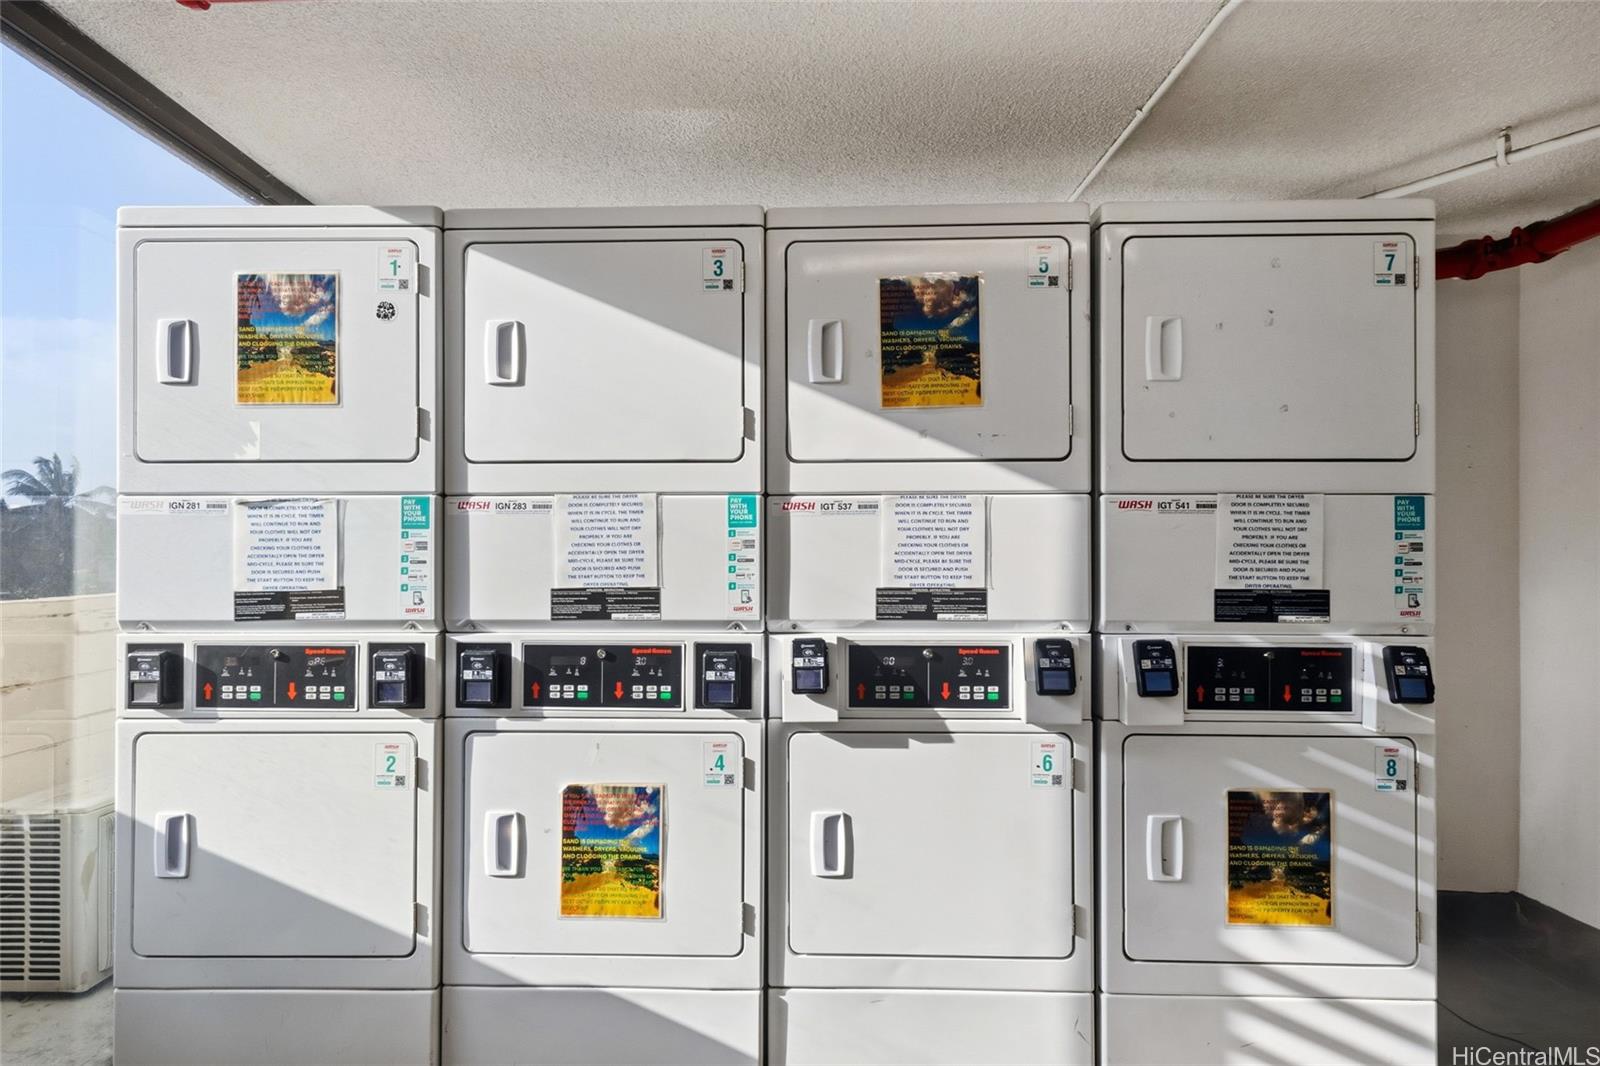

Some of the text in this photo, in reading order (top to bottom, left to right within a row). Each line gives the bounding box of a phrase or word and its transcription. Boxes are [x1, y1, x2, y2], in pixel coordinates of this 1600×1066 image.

[390, 260, 397, 276] 1
[714, 260, 723, 276] 3
[1039, 256, 1048, 273] 5
[1385, 254, 1395, 271] 7
[457, 501, 490, 510] WASH
[782, 502, 816, 510] WASH
[1118, 501, 1152, 509] WASH
[386, 755, 396, 772] 2
[715, 754, 725, 771] 4
[1043, 754, 1053, 772] 6
[1387, 759, 1396, 777] 8
